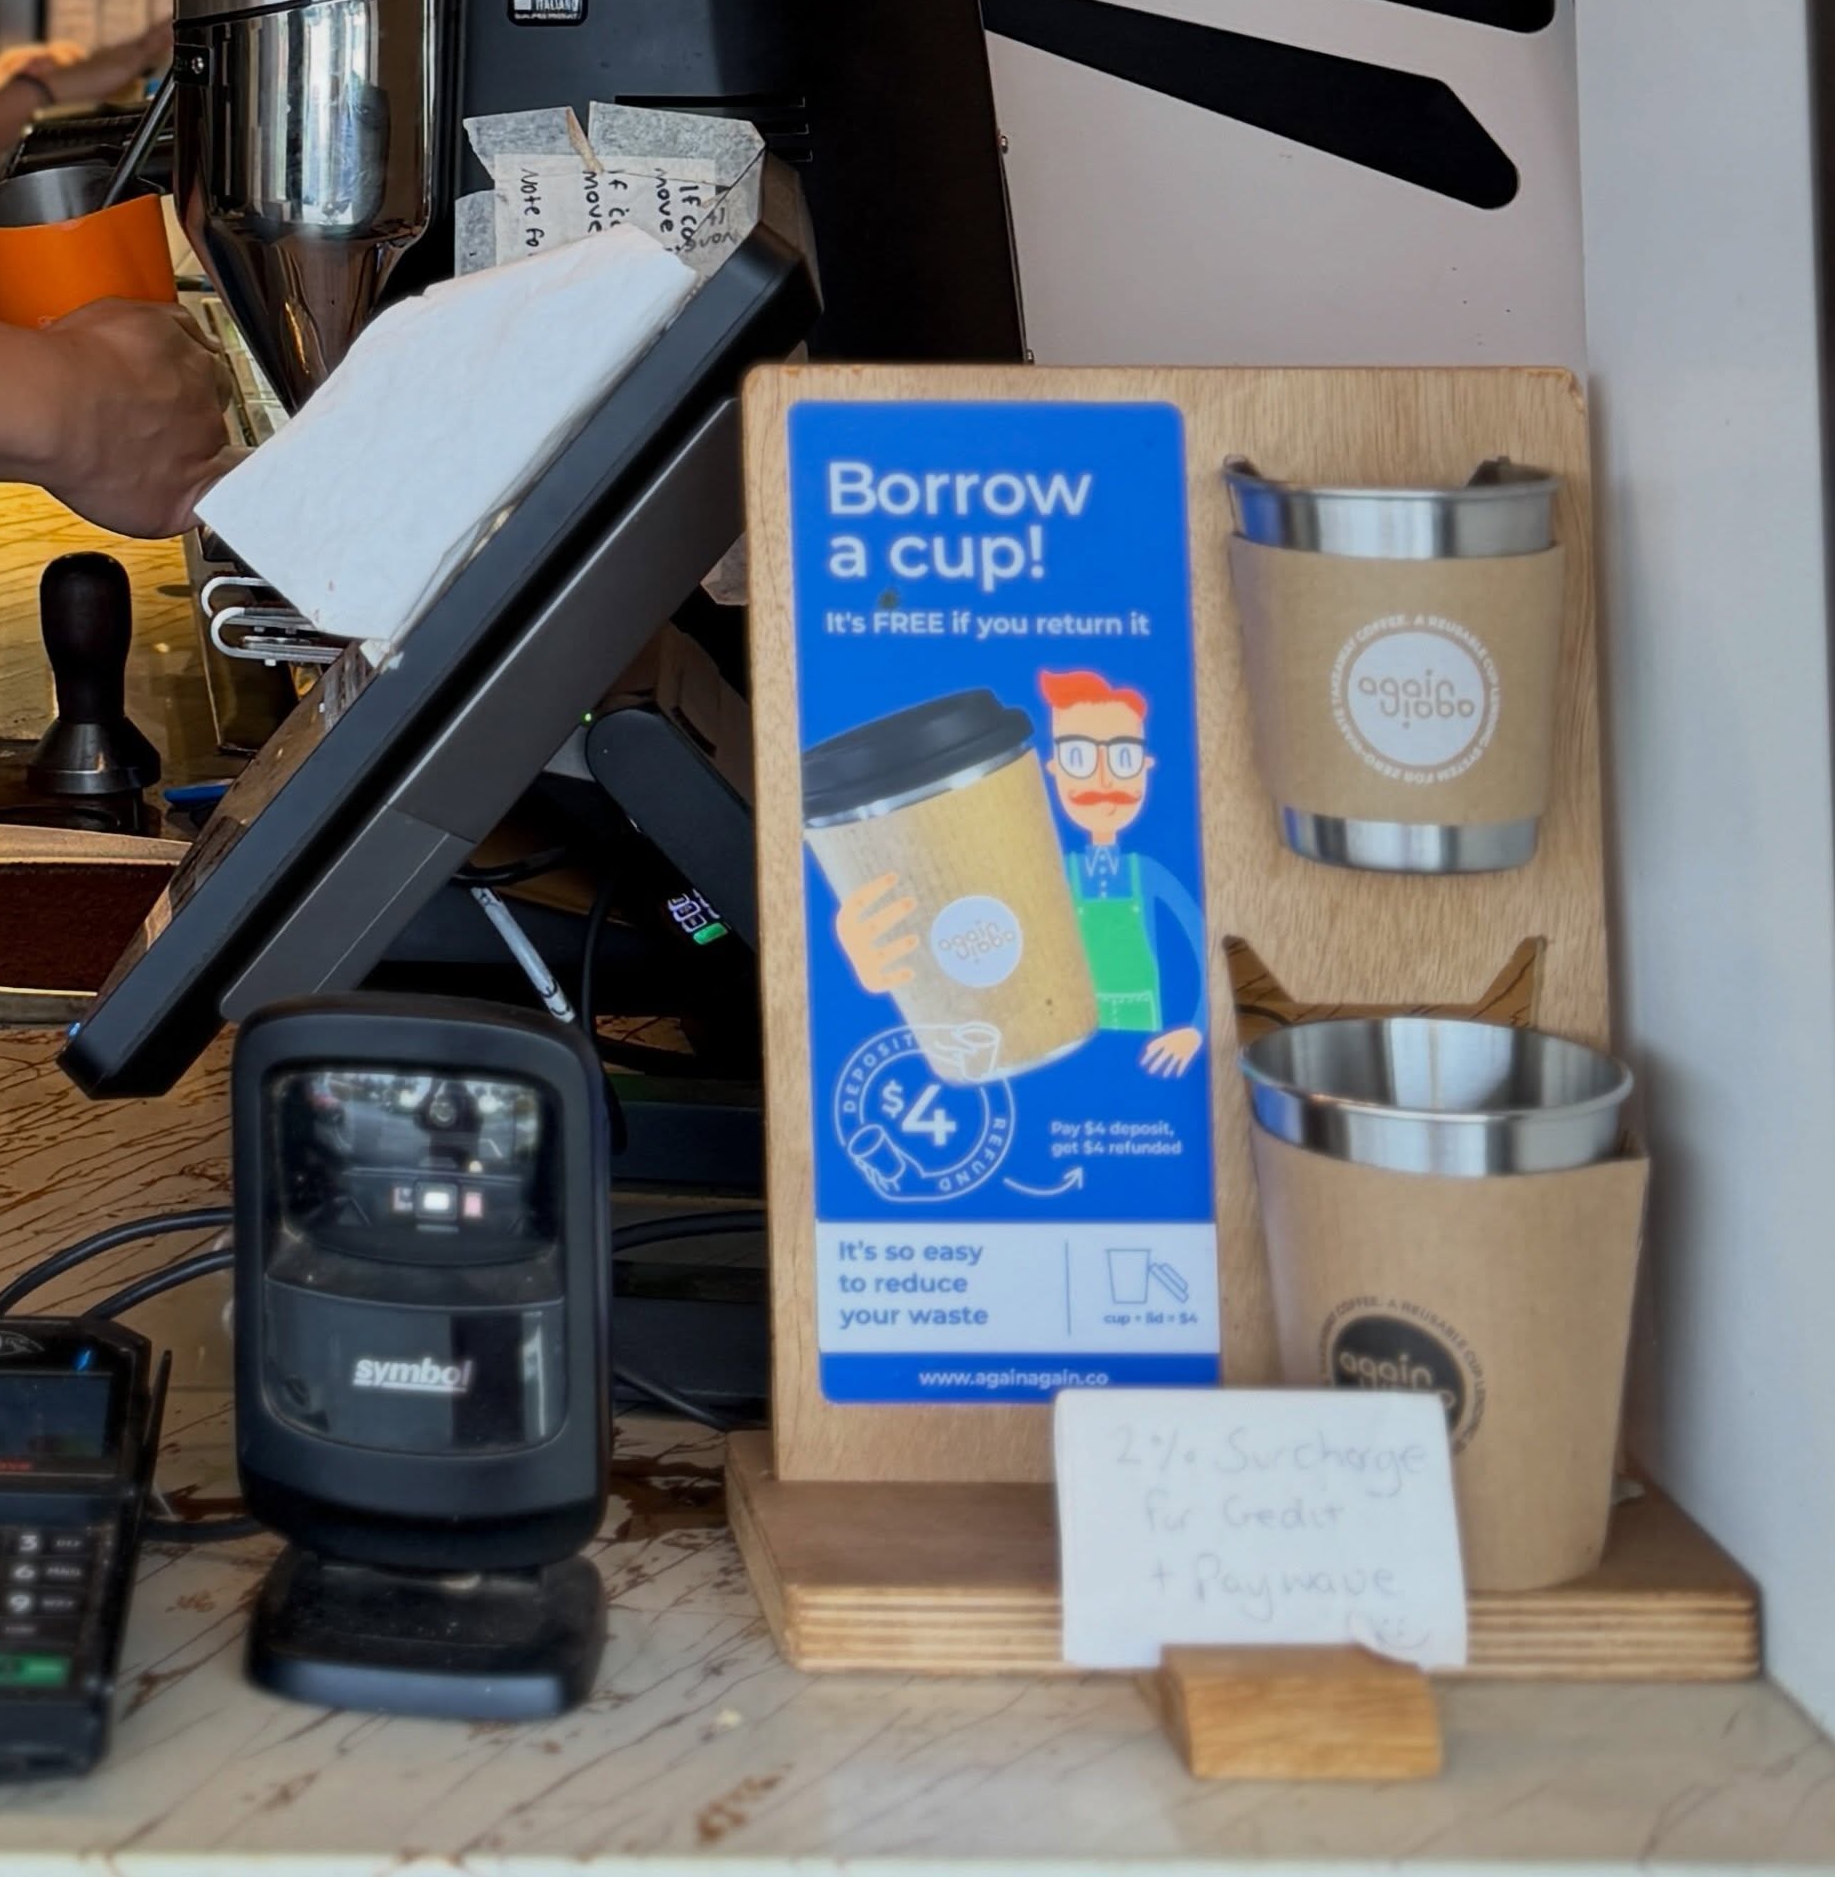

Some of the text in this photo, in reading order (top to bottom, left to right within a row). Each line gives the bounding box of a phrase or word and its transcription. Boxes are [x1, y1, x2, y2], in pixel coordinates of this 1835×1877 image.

[520, 168, 542, 217] Note
[828, 461, 1092, 516] Borrow
[828, 526, 1045, 592] a cup!
[826, 611, 1150, 640] It's FREE if you return it
[1358, 668, 1455, 717] again
[843, 1034, 912, 1114] DEPOSIT
[881, 1079, 957, 1147] $4
[1051, 1120, 1175, 1138] Pay $4 deposit,
[939, 1117, 1007, 1192] REFUND
[1051, 1140, 1182, 1157] get $4 refunded
[839, 1240, 983, 1265] It's so easy
[839, 1274, 968, 1294] to reduce
[839, 1305, 988, 1329] your waste
[1103, 1314, 1131, 1326] cup
[352, 1357, 474, 1390] symbol
[919, 1368, 1109, 1387] www.againagain.co
[1212, 1426, 1427, 1498] Surcharge
[19, 1534, 38, 1551] 3
